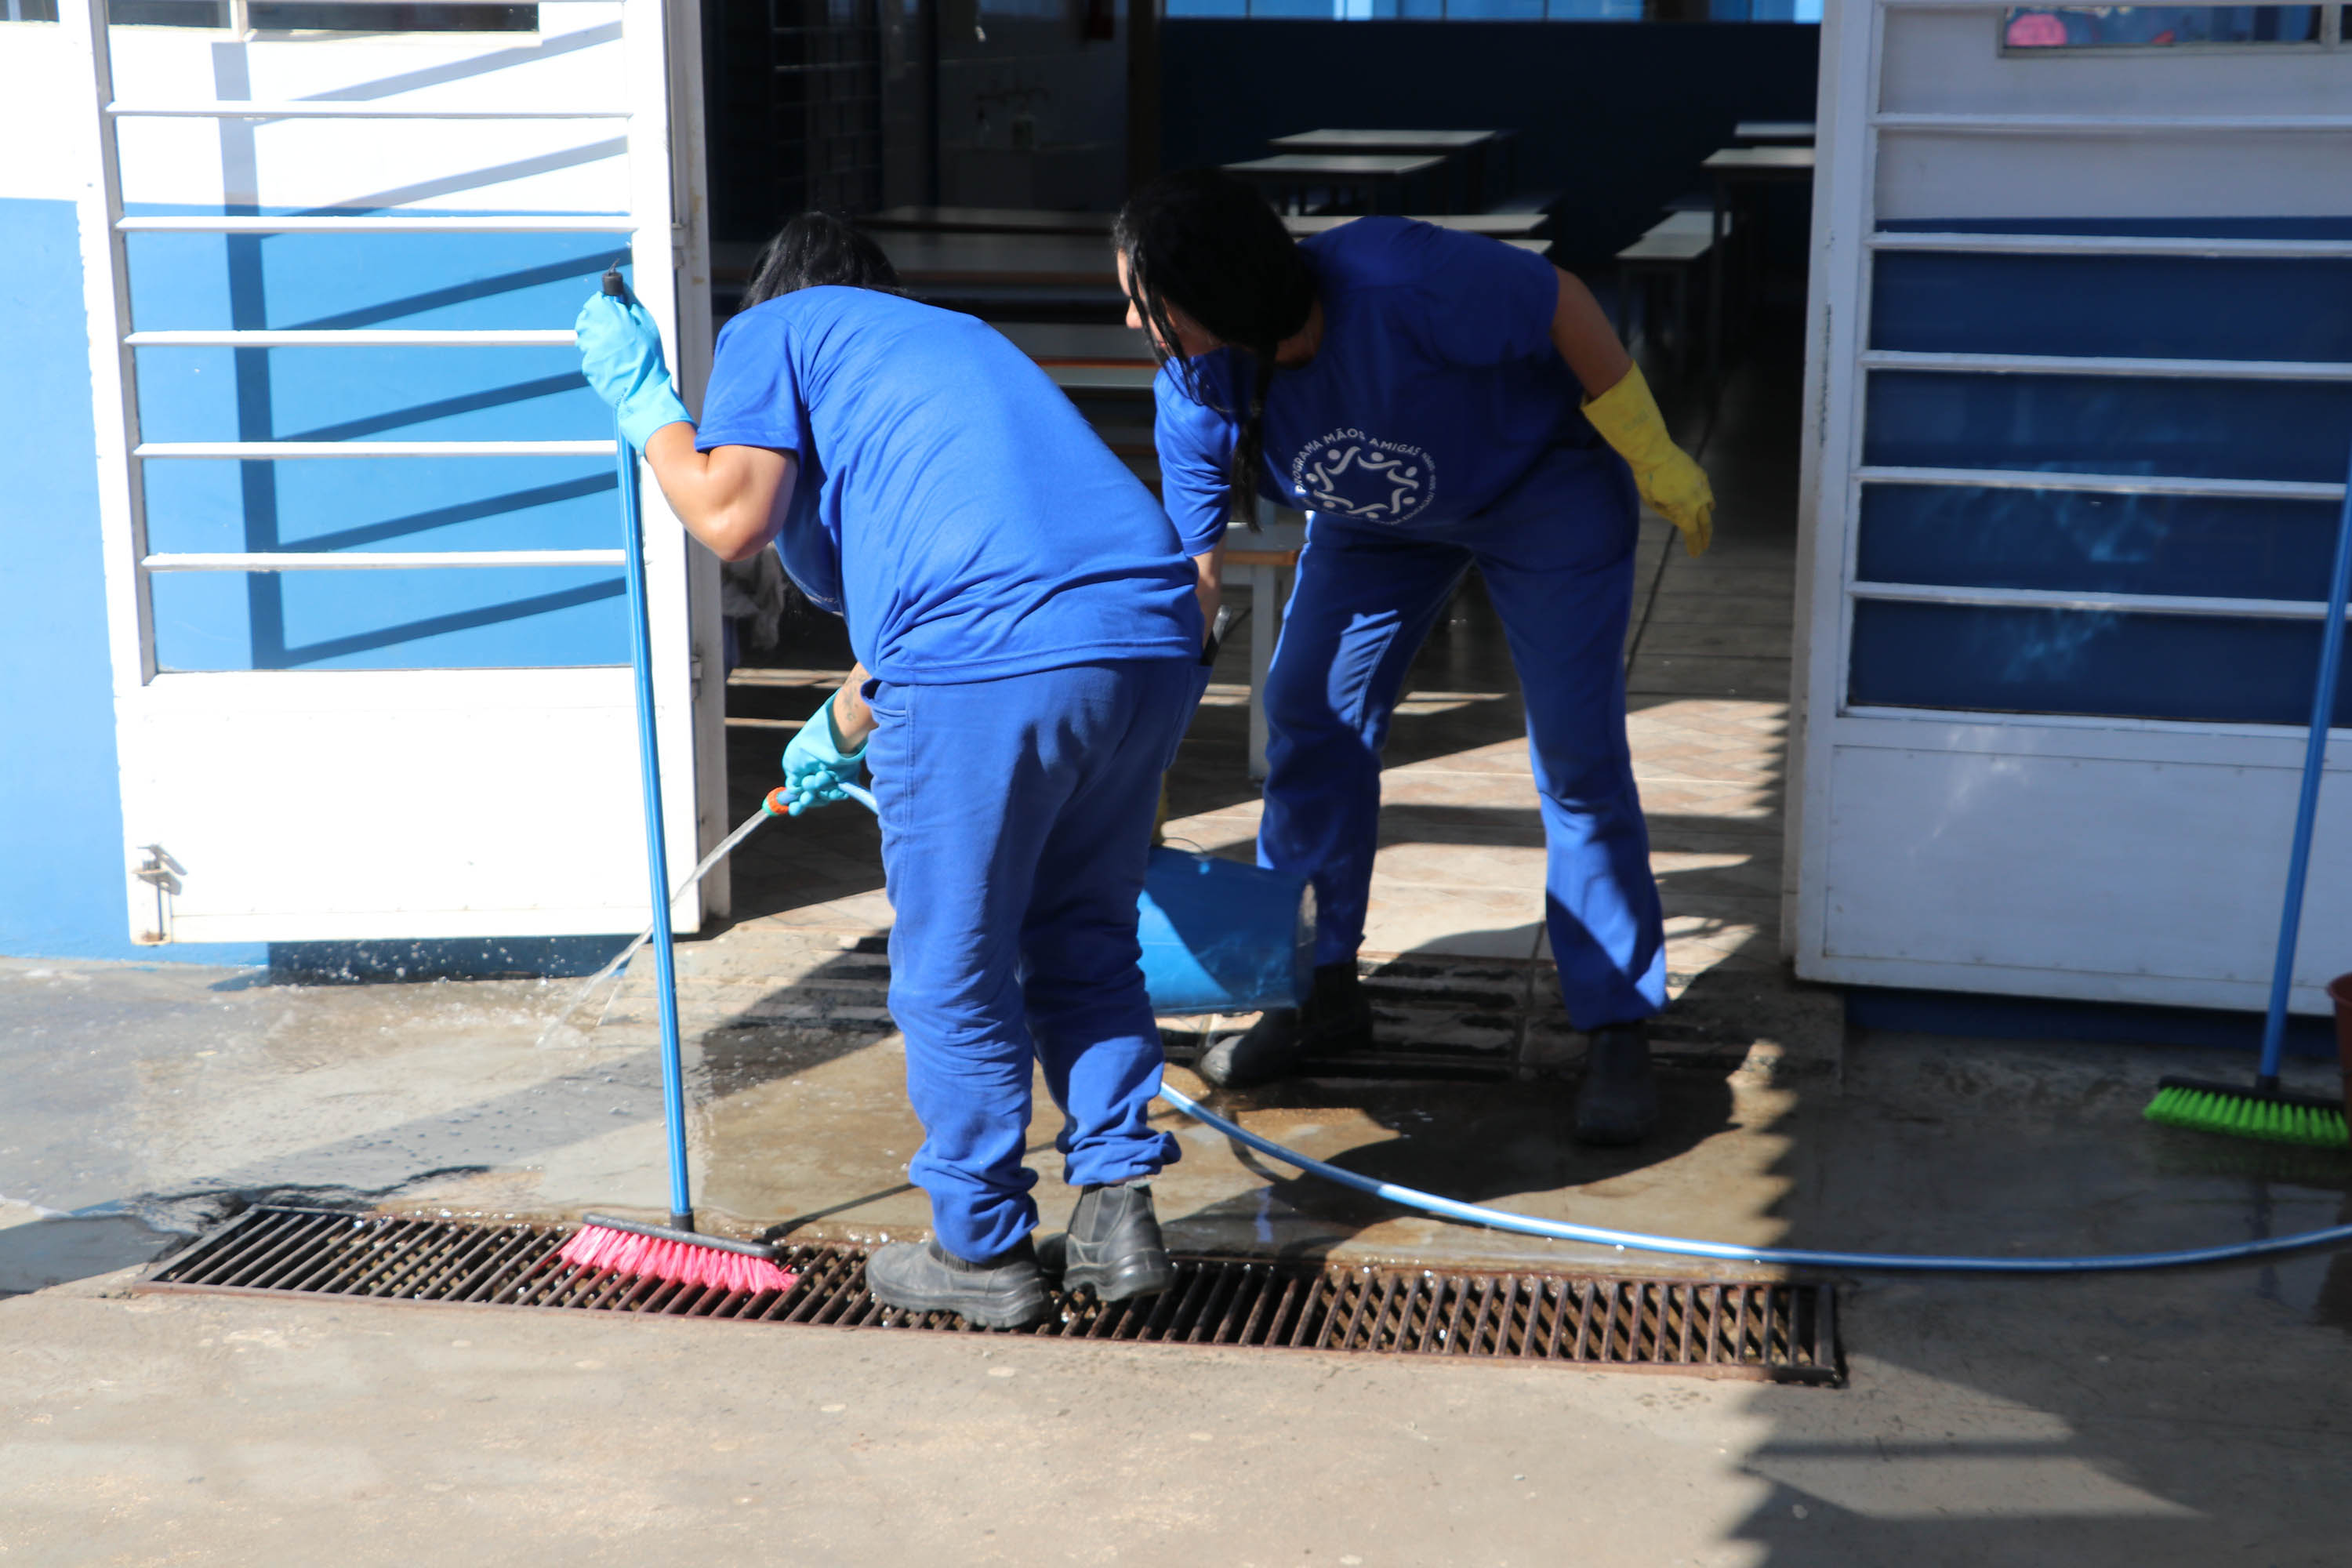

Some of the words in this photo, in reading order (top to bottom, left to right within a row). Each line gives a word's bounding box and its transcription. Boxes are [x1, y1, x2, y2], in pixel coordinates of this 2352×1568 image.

[1293, 440, 1323, 494] PROGRAMA
[1323, 428, 1366, 444] MÃOS
[1369, 437, 1421, 456] AMIGAS
